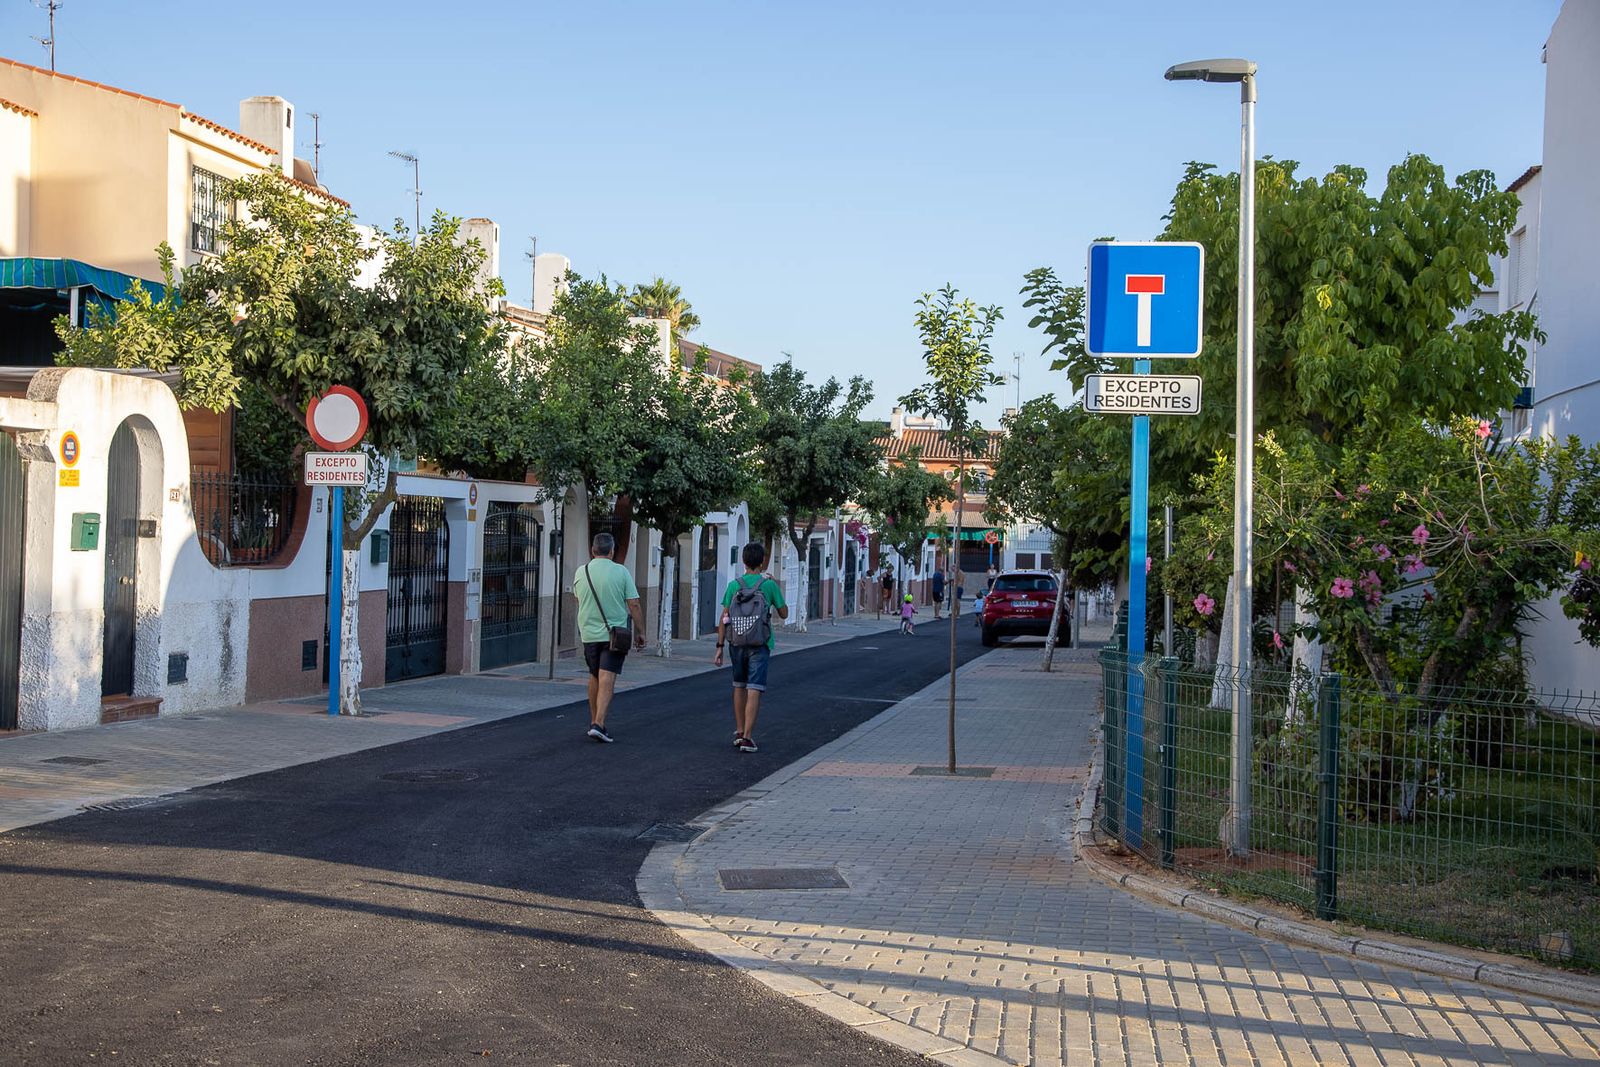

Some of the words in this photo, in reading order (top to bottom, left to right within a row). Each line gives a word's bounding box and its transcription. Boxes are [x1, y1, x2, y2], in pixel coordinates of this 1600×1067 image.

[1105, 380, 1181, 393] EXCEPTO
[1094, 395, 1192, 409] RESIDENTES
[315, 457, 357, 467] EXCEPTO
[307, 471, 364, 481] RESIDENTES
